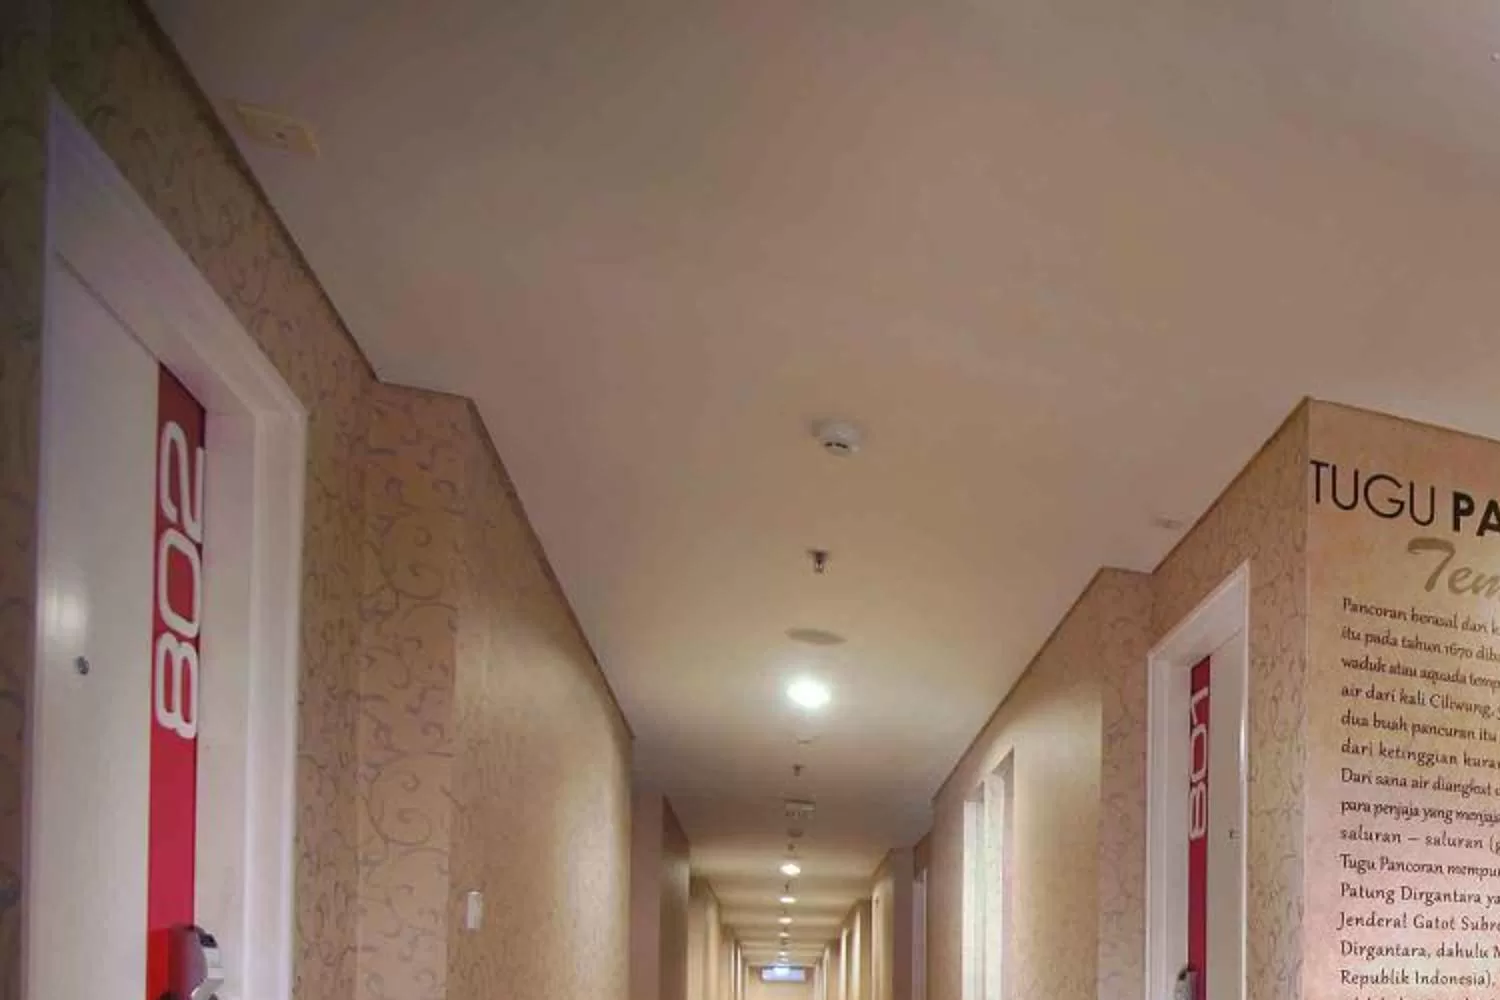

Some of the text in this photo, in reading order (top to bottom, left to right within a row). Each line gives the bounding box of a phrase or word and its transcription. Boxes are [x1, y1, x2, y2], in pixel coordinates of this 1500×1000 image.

[1310, 460, 1435, 526] TUGU
[155, 420, 204, 740] 802
[1343, 597, 1407, 621] Pancoran
[1411, 607, 1458, 630] berasal
[1365, 628, 1397, 647] pada
[1402, 633, 1441, 653] tahun
[1341, 656, 1386, 673] waduk
[1366, 683, 1395, 702] dari
[1400, 688, 1425, 706] kali
[1341, 709, 1369, 727] dua
[1373, 712, 1407, 731] buah
[1411, 720, 1475, 738] pancuran
[1479, 728, 1496, 741] itu
[1341, 737, 1373, 757] dari
[1379, 740, 1457, 767] ketinggian
[1341, 767, 1373, 785] Dari
[1376, 775, 1406, 788] sana
[1411, 776, 1430, 789] air
[1341, 800, 1370, 816] para
[1422, 807, 1453, 824] yang
[1340, 824, 1401, 843] saluran
[1425, 831, 1483, 849] saluran
[1340, 854, 1376, 874] Tugu
[1380, 856, 1444, 875] Pancoran
[1341, 882, 1395, 904] Patung
[1400, 885, 1482, 906] Dirgantara
[1336, 911, 1407, 930] Jenderal
[1413, 913, 1456, 930] Gatot
[1340, 940, 1431, 960] Dirgantara,
[1436, 942, 1489, 959] dahulu
[1340, 968, 1409, 989] Republik
